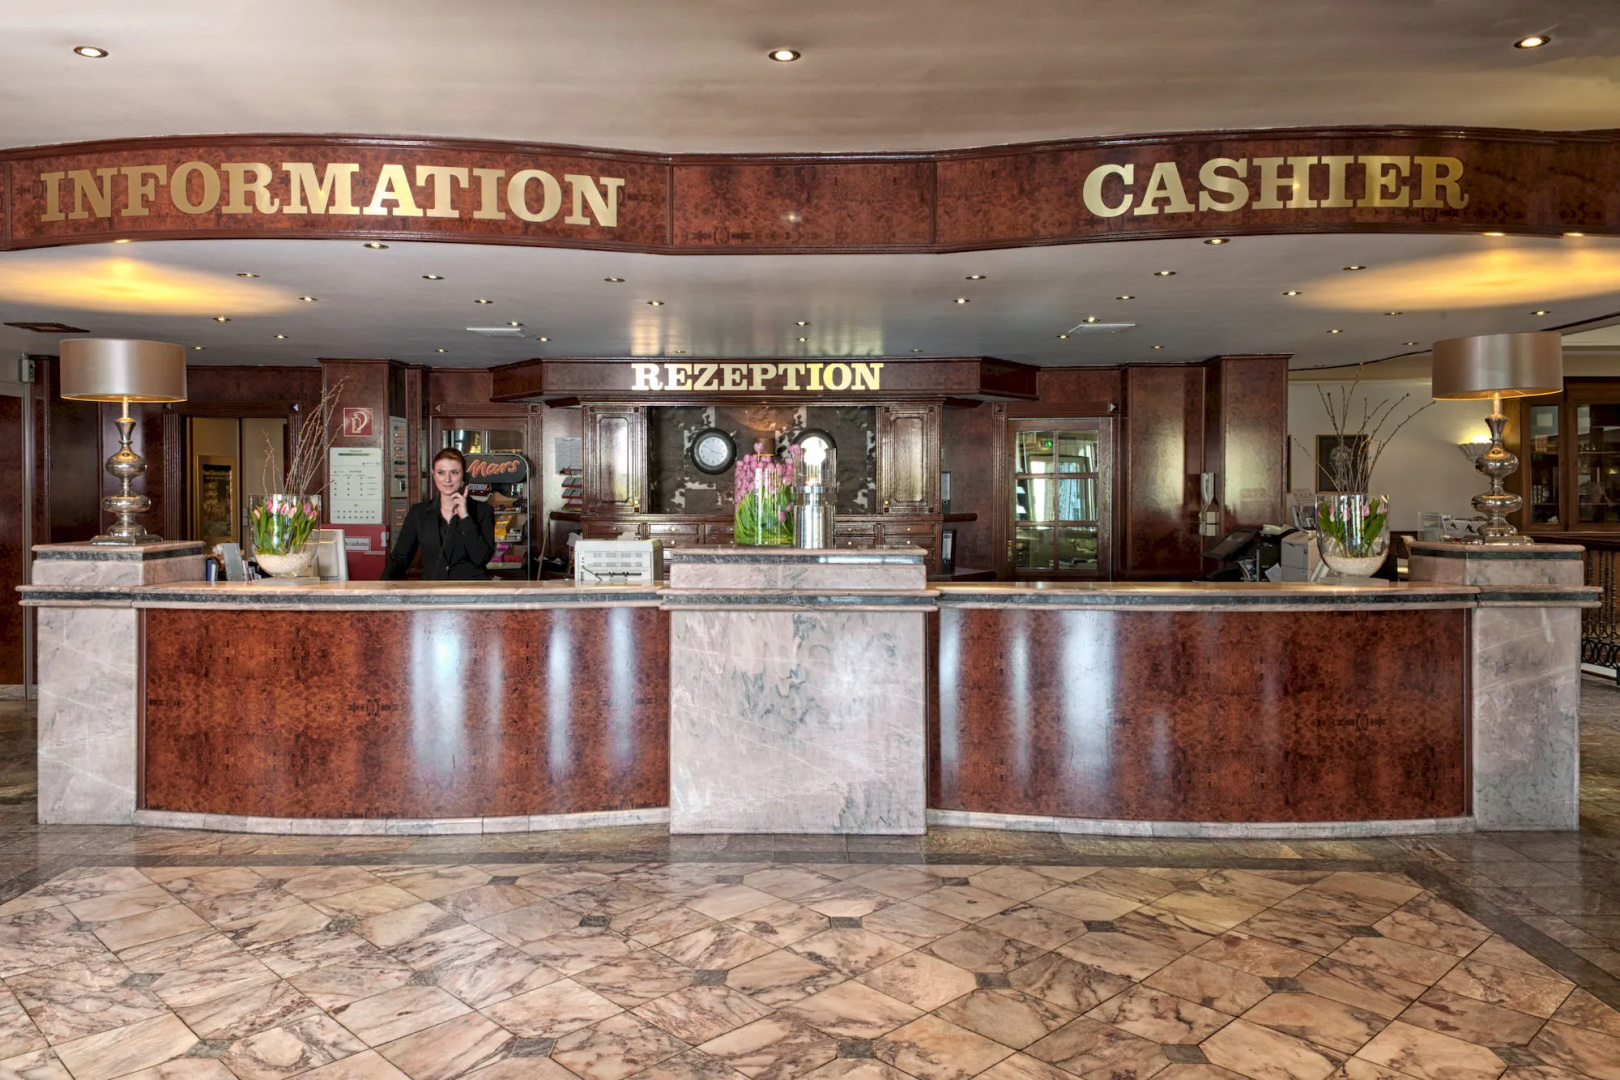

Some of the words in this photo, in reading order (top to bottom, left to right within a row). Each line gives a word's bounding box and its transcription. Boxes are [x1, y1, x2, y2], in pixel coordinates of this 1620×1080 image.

[40, 161, 625, 227] INFORMATION
[1082, 155, 1469, 218] CASHIER
[631, 362, 884, 391] REZEPTION
[466, 459, 520, 478] Mars
